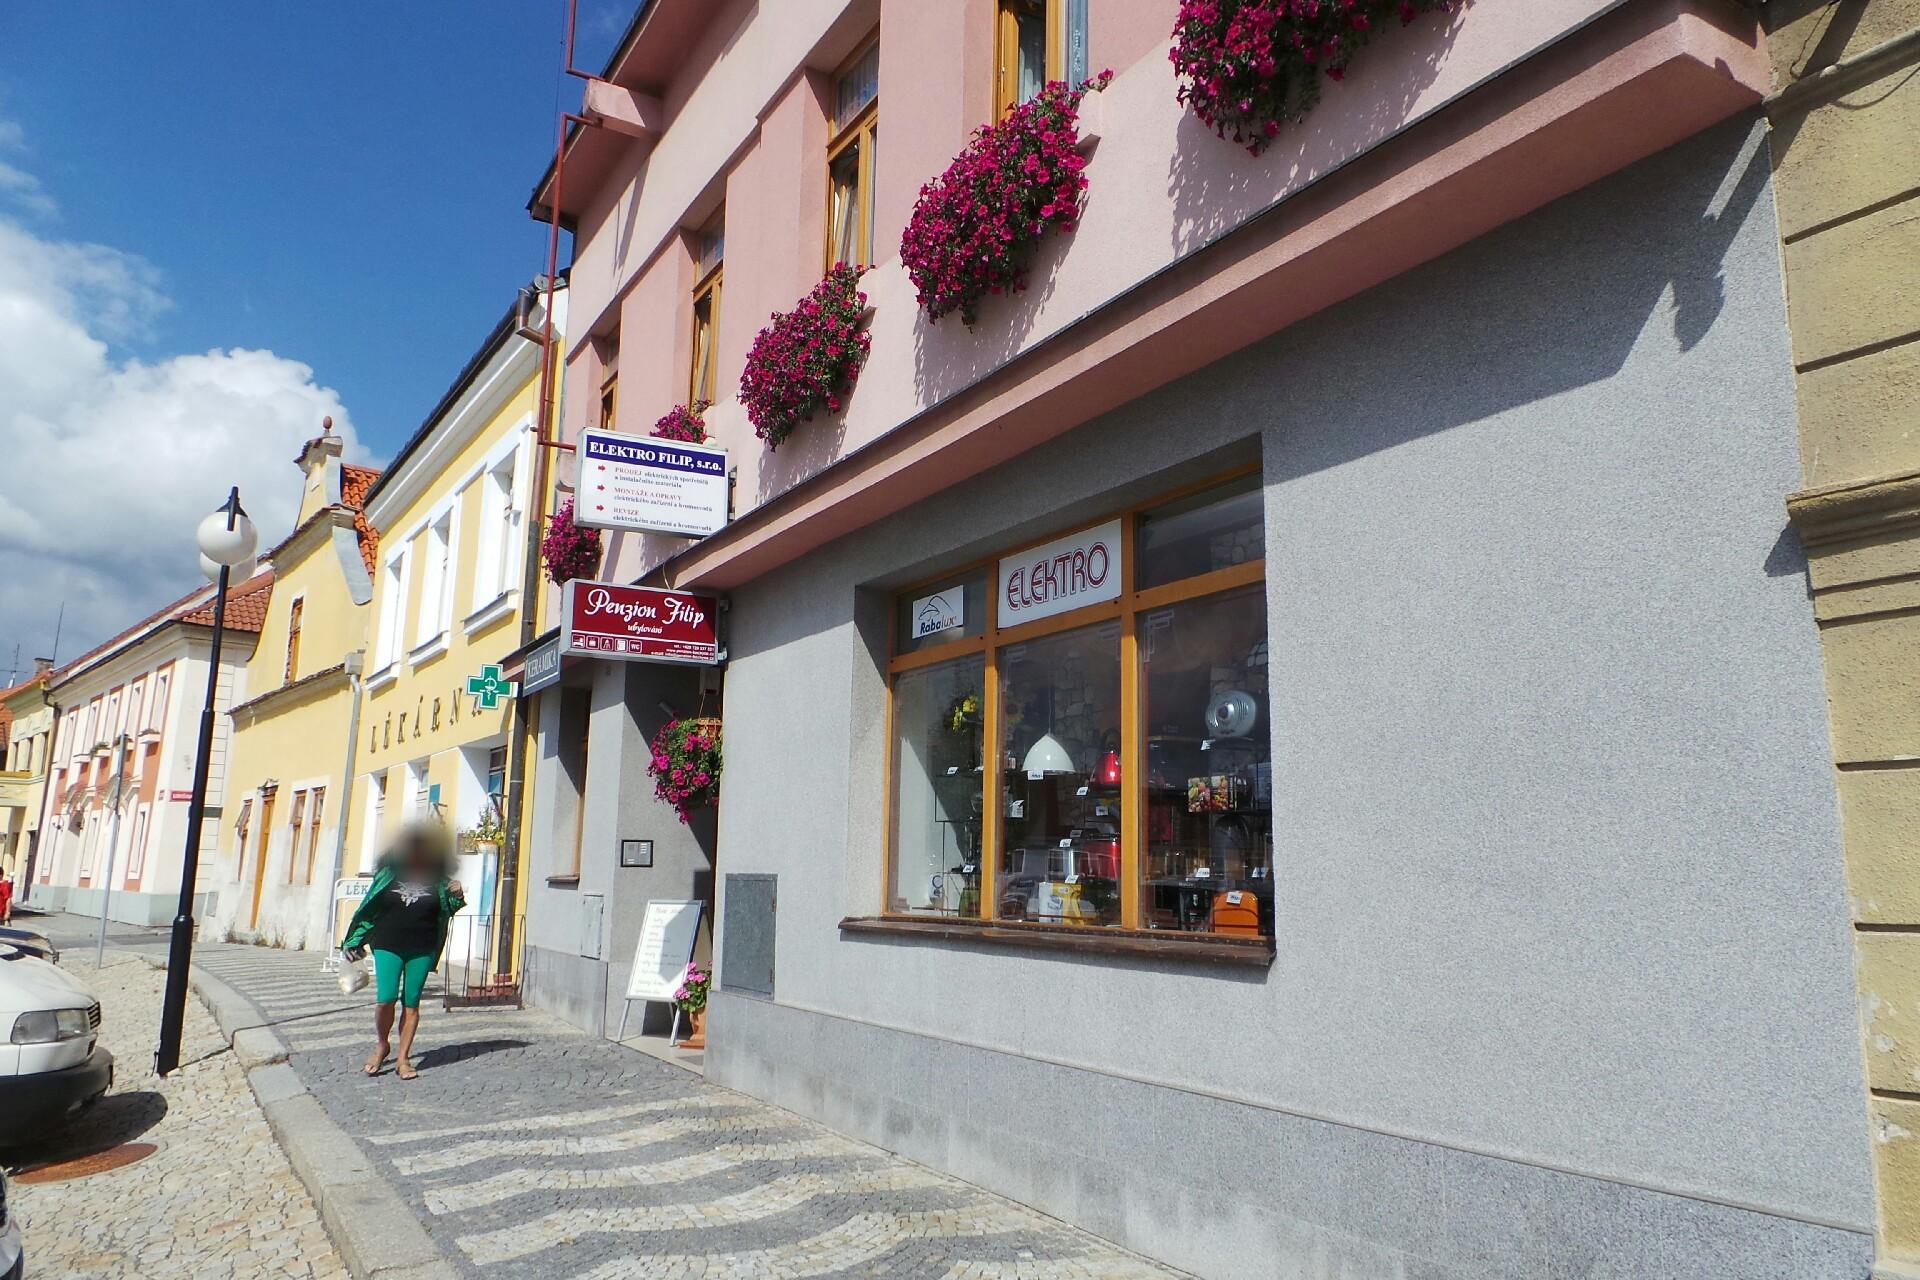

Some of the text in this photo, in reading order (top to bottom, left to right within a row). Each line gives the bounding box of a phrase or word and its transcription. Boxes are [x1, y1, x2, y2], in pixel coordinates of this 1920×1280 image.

[589, 441, 723, 471] ELEKTRO FILIP, s.r.o.
[615, 467, 642, 475] PRODEJ
[614, 487, 648, 496] MONTÁŽE
[656, 492, 682, 500] OPRAVY
[613, 507, 640, 515] REVIZE
[1006, 541, 1110, 611] ELEKTRO
[584, 588, 705, 629] Penzion Filip
[919, 615, 955, 635] Rabalux
[630, 642, 640, 651] WC
[527, 648, 557, 679] KERAMIKA
